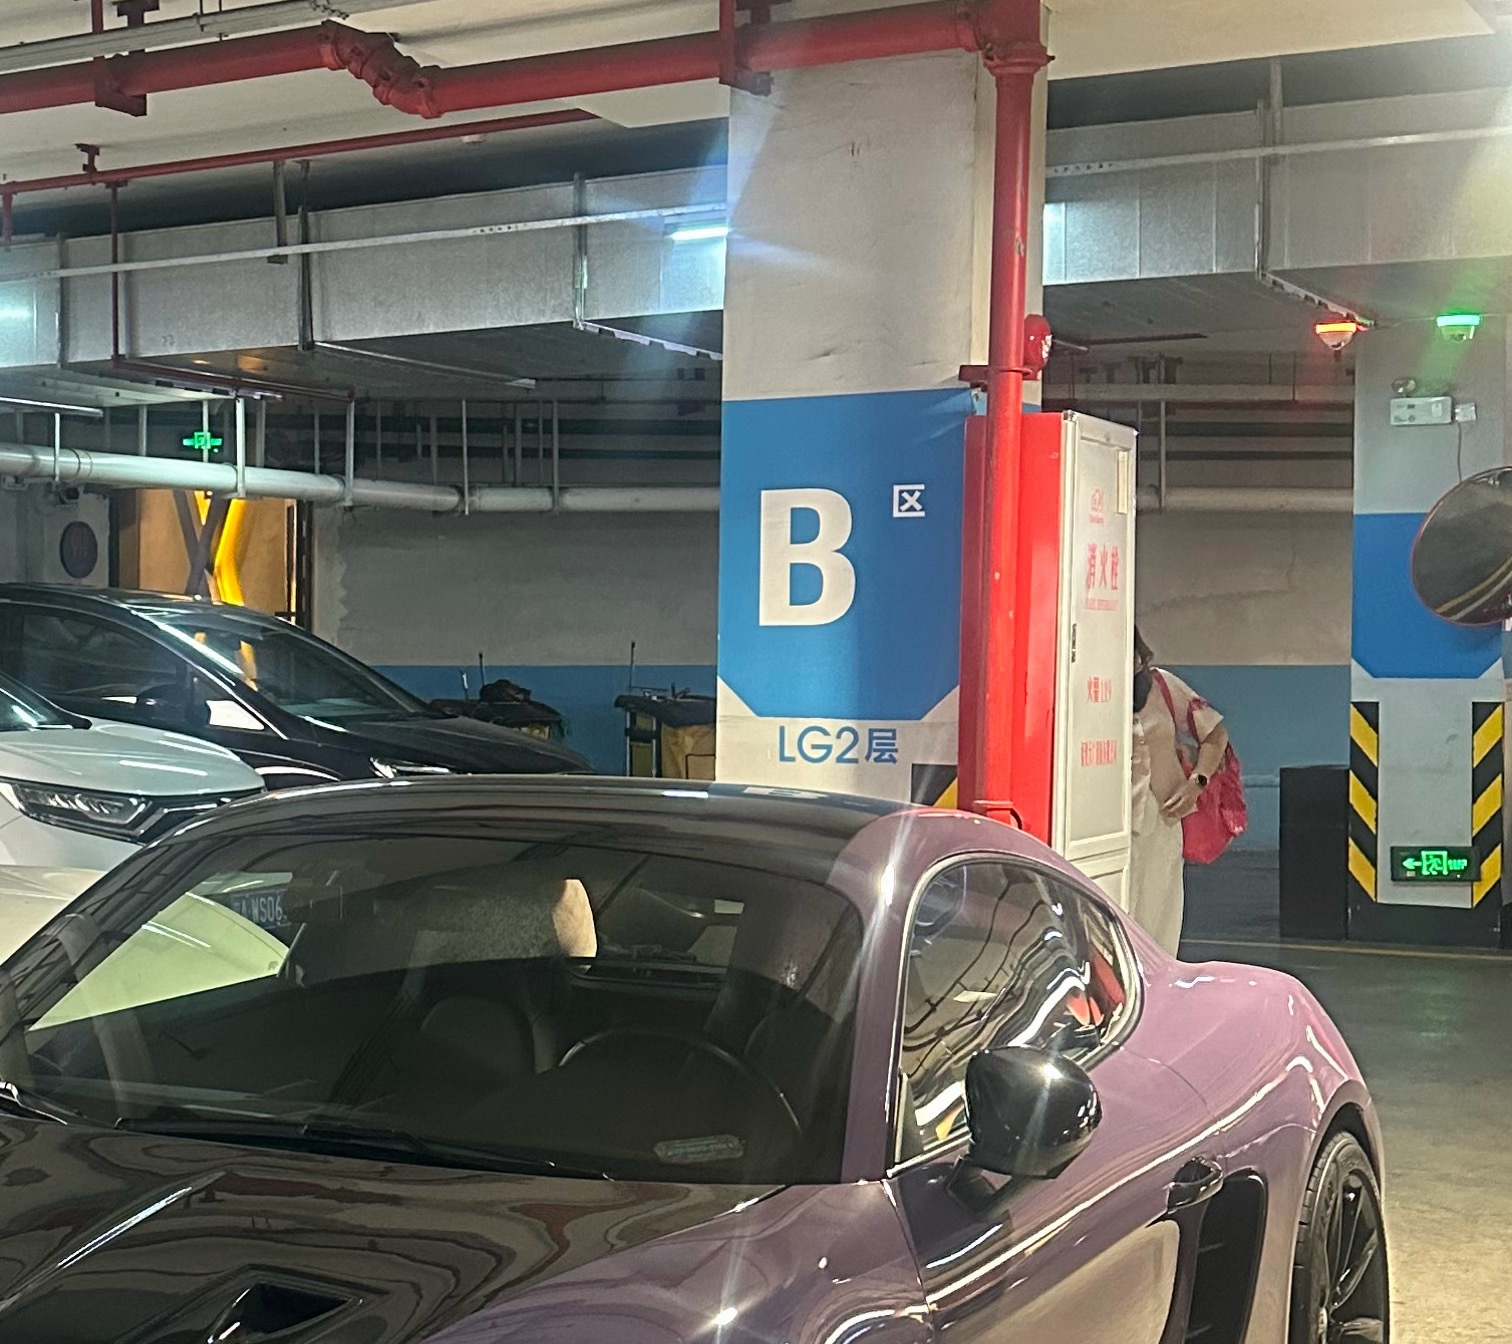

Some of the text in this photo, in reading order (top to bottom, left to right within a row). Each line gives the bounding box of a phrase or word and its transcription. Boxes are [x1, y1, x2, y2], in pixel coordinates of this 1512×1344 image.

[759, 483, 926, 627] B 区
[777, 725, 900, 765] LG2层
